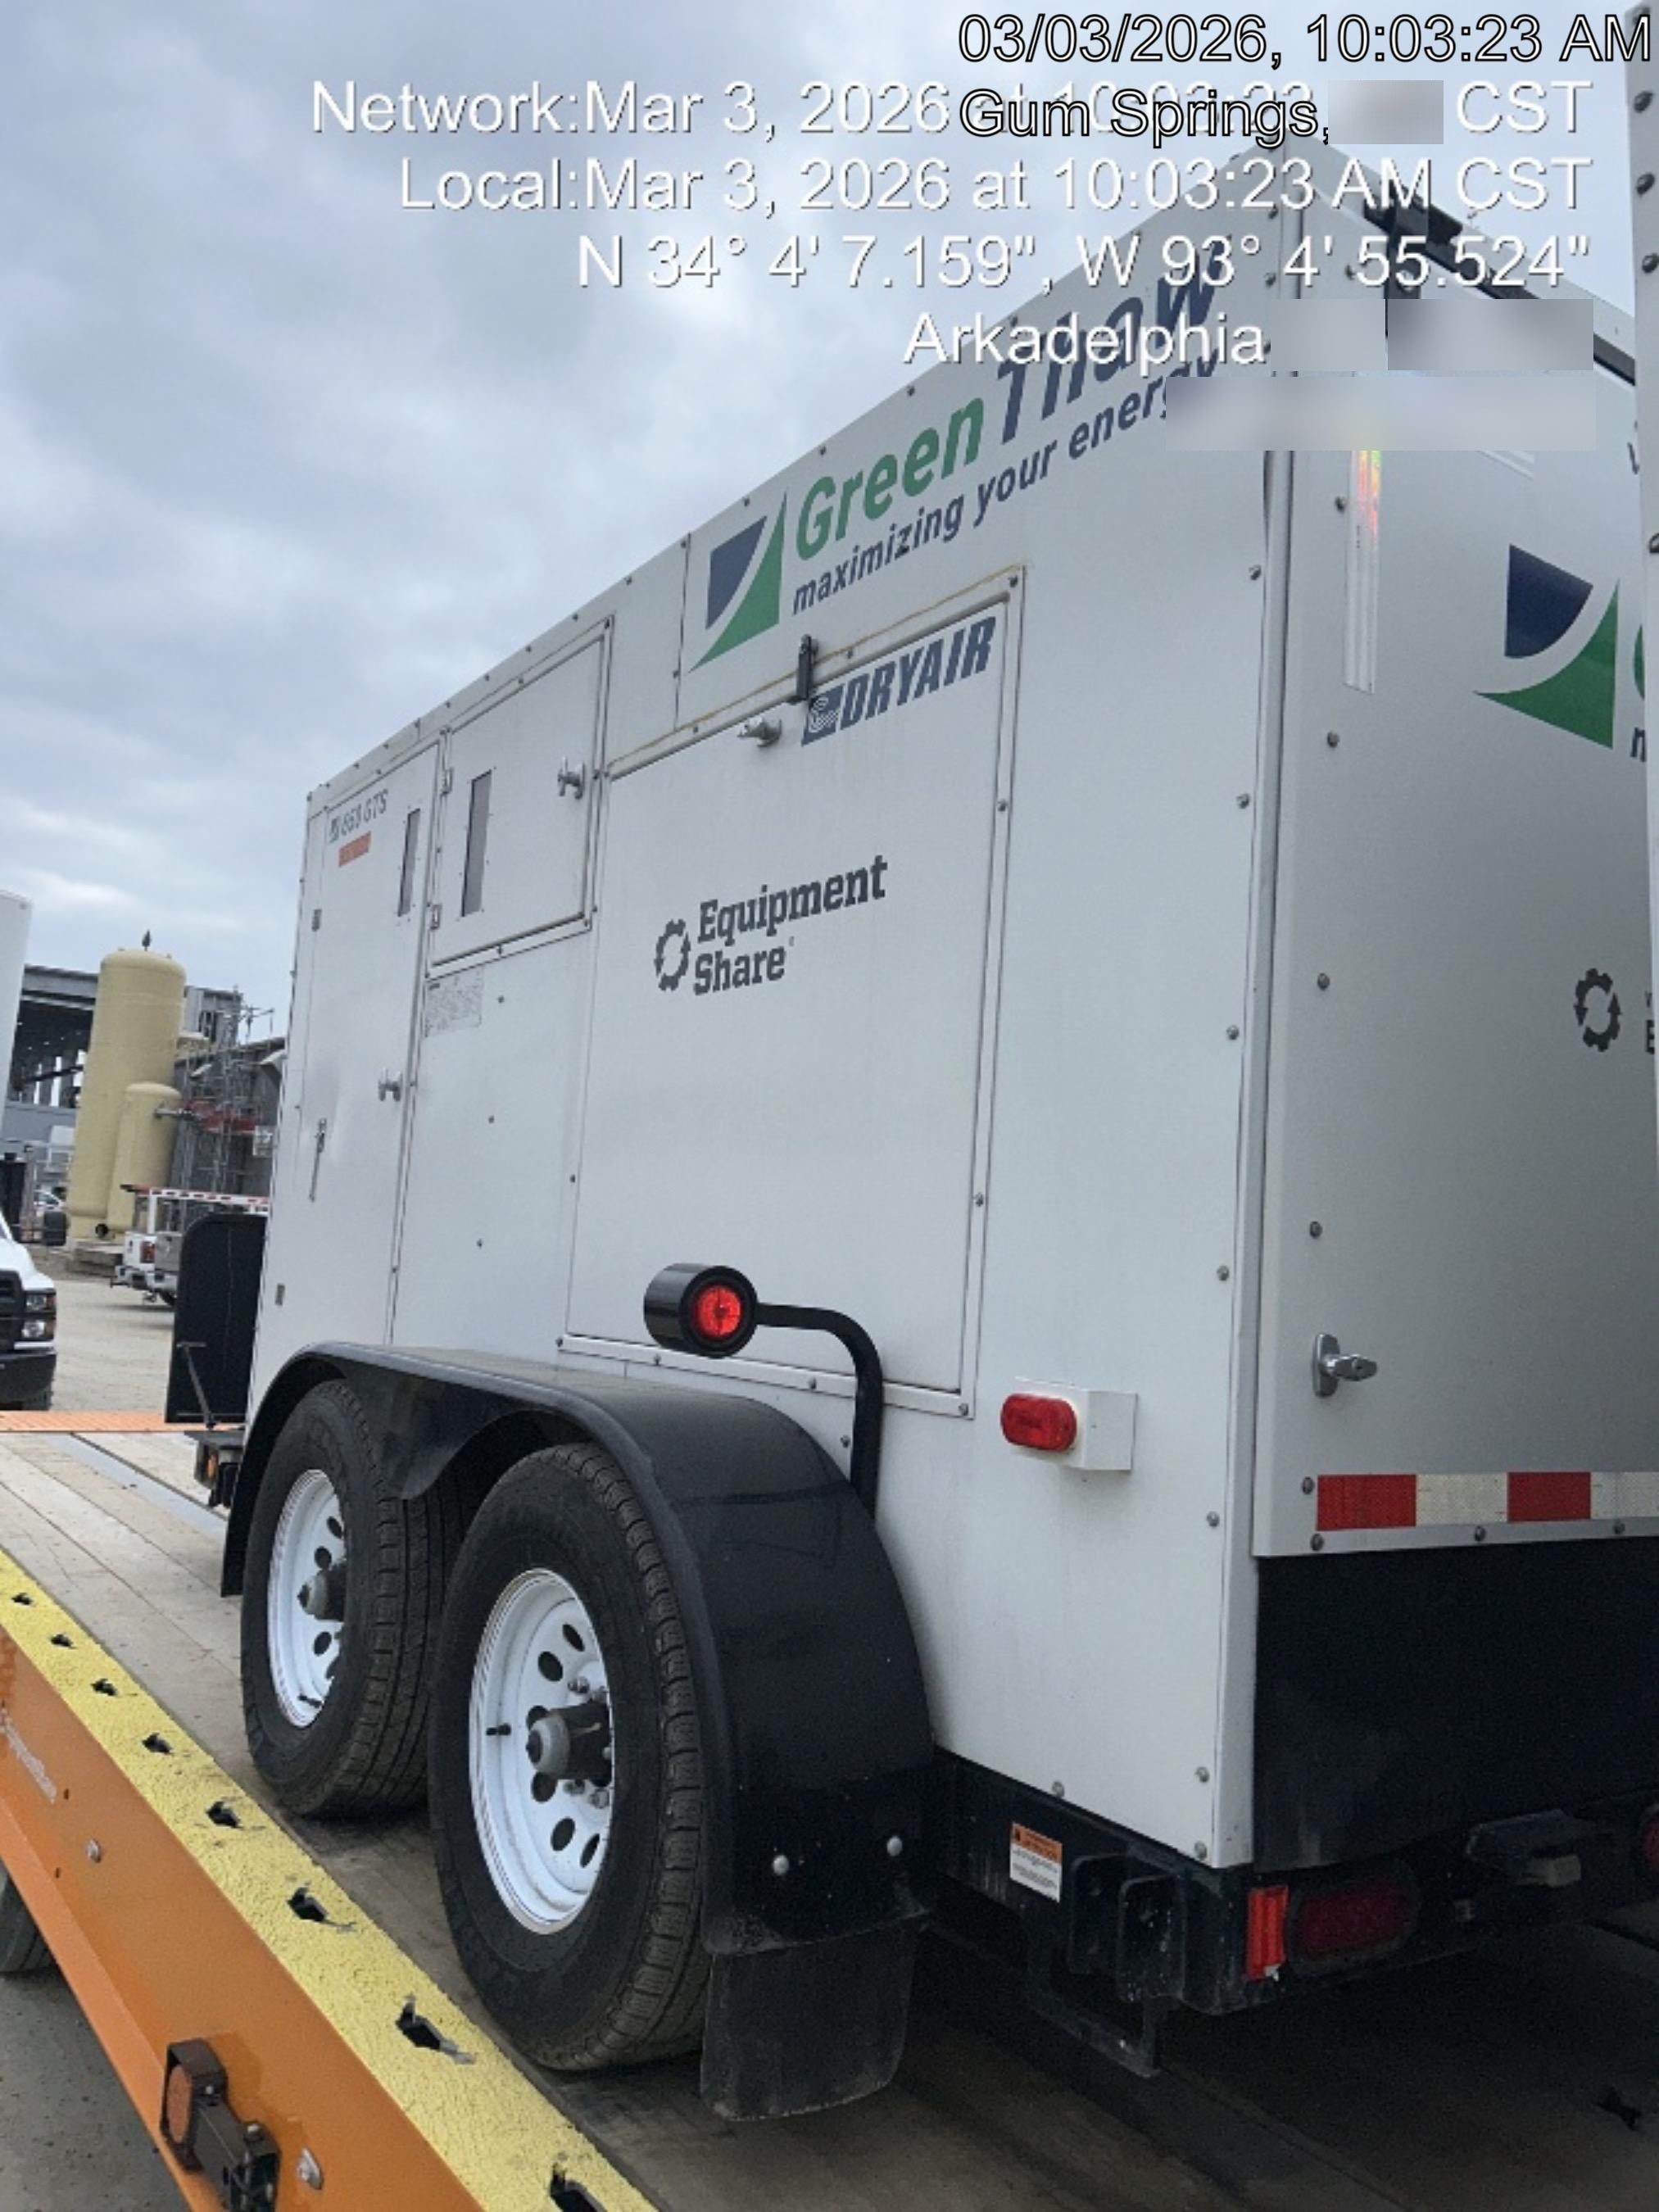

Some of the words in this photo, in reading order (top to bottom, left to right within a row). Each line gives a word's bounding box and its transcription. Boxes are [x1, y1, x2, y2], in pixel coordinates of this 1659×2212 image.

[793, 491, 963, 615] maximizing
[973, 440, 1057, 526] your
[839, 615, 997, 731] DRYAIR
[698, 855, 887, 946] Equipment
[693, 946, 785, 996] Share
